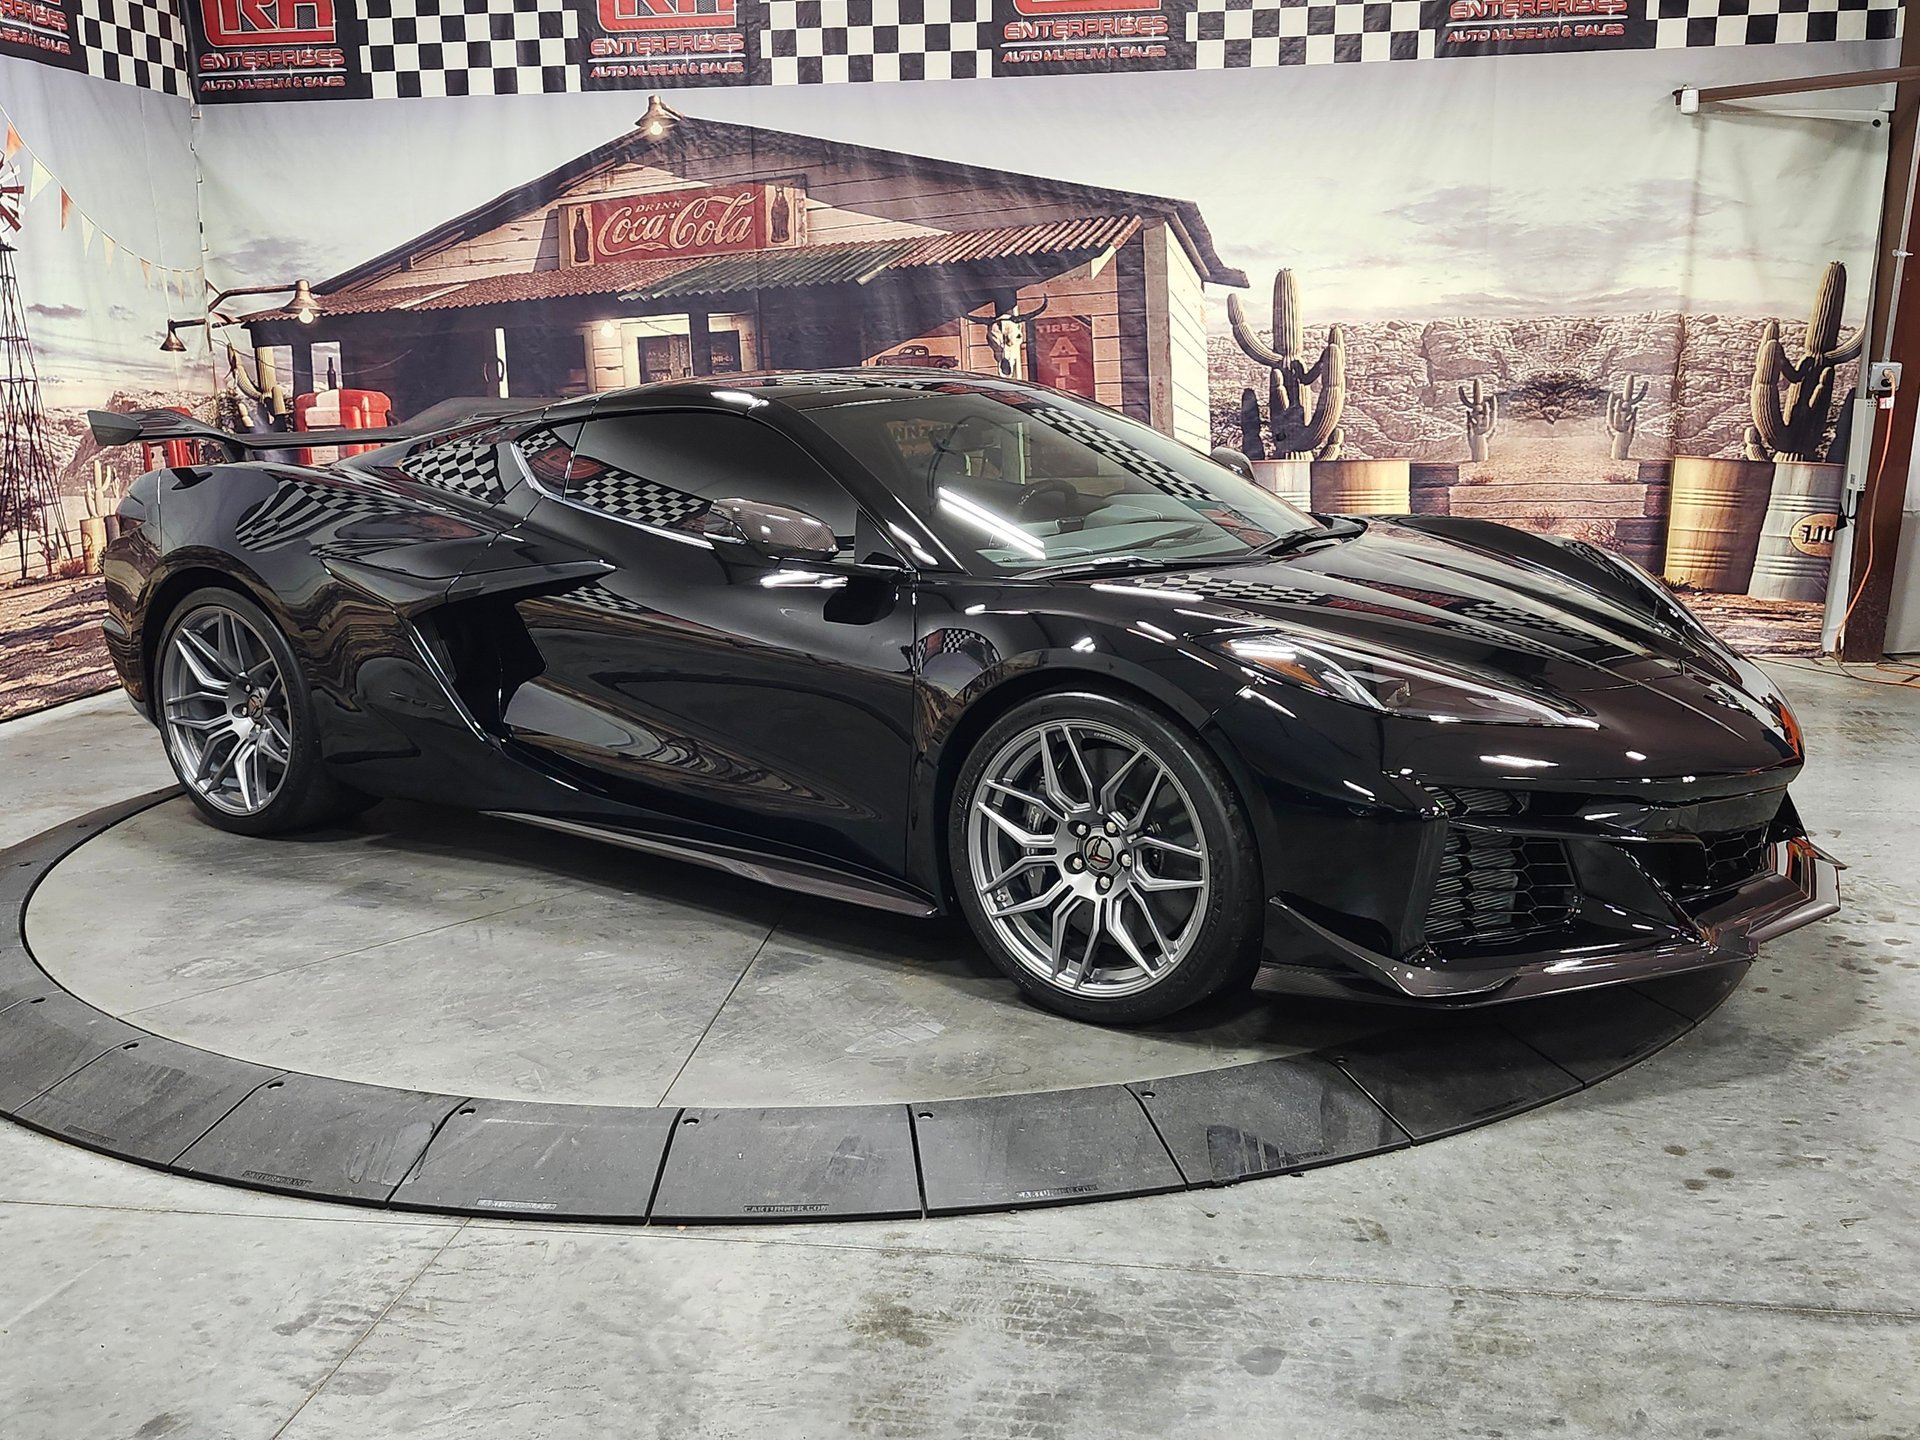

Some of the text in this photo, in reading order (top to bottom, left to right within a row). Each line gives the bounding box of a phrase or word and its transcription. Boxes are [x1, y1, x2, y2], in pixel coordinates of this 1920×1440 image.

[0, 0, 68, 31] RPRISES
[1450, 0, 1628, 19] ENTERPRISES
[1003, 15, 1169, 40] ENTERPRISES
[1447, 24, 1625, 43] AUTO MUSEUM & SALES
[590, 33, 745, 56] ENTERPRISES
[1002, 45, 1167, 63] AUTO MUSEUM & SALES
[199, 48, 346, 70] ENTERPRISES
[590, 61, 744, 78] AUTO MUSEUM & SALES
[201, 76, 346, 91] AUTO MUSEUM & SALES
[635, 200, 684, 214] DRINK
[596, 191, 759, 256] Coca-Cola
[1036, 322, 1081, 334] TIRES
